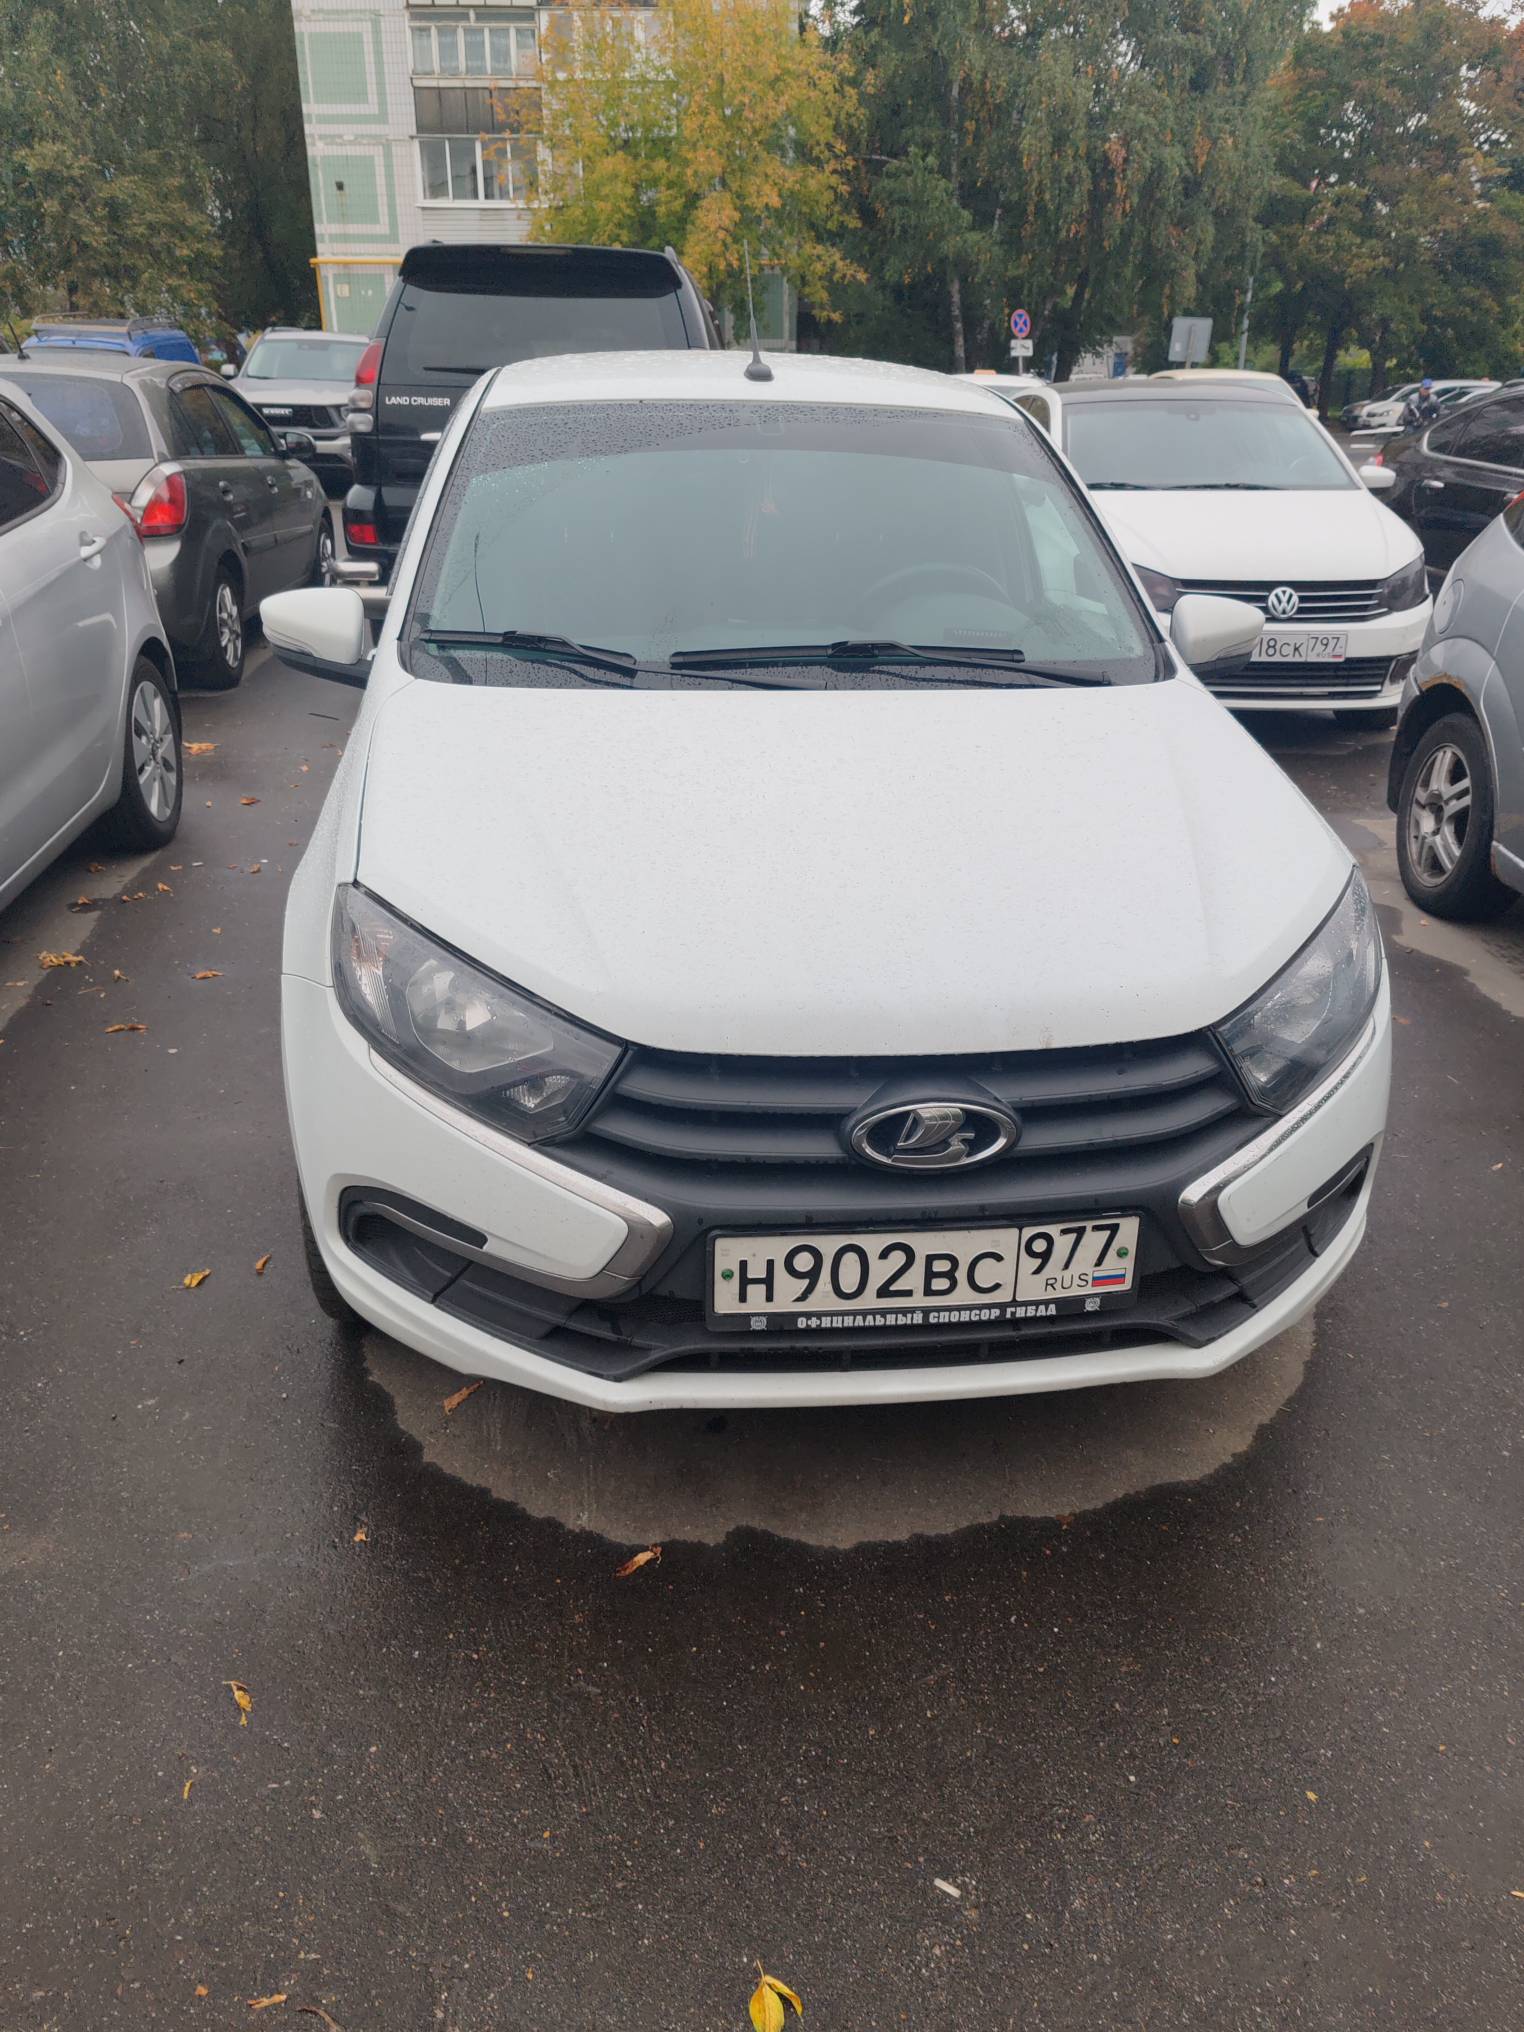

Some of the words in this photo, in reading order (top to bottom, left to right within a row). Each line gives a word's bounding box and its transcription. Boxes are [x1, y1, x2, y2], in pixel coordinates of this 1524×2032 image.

[385, 396, 410, 405] LAND
[411, 397, 451, 406] CRUISER
[1310, 636, 1340, 652] 797
[1024, 1222, 1120, 1275] 977
[1045, 1273, 1089, 1292] RUS
[797, 1310, 923, 1329] ОФИЦИАЛЬНЫЙ
[929, 1308, 1000, 1323] СПОНСОР
[1006, 1303, 1057, 1319] ГИБДД
